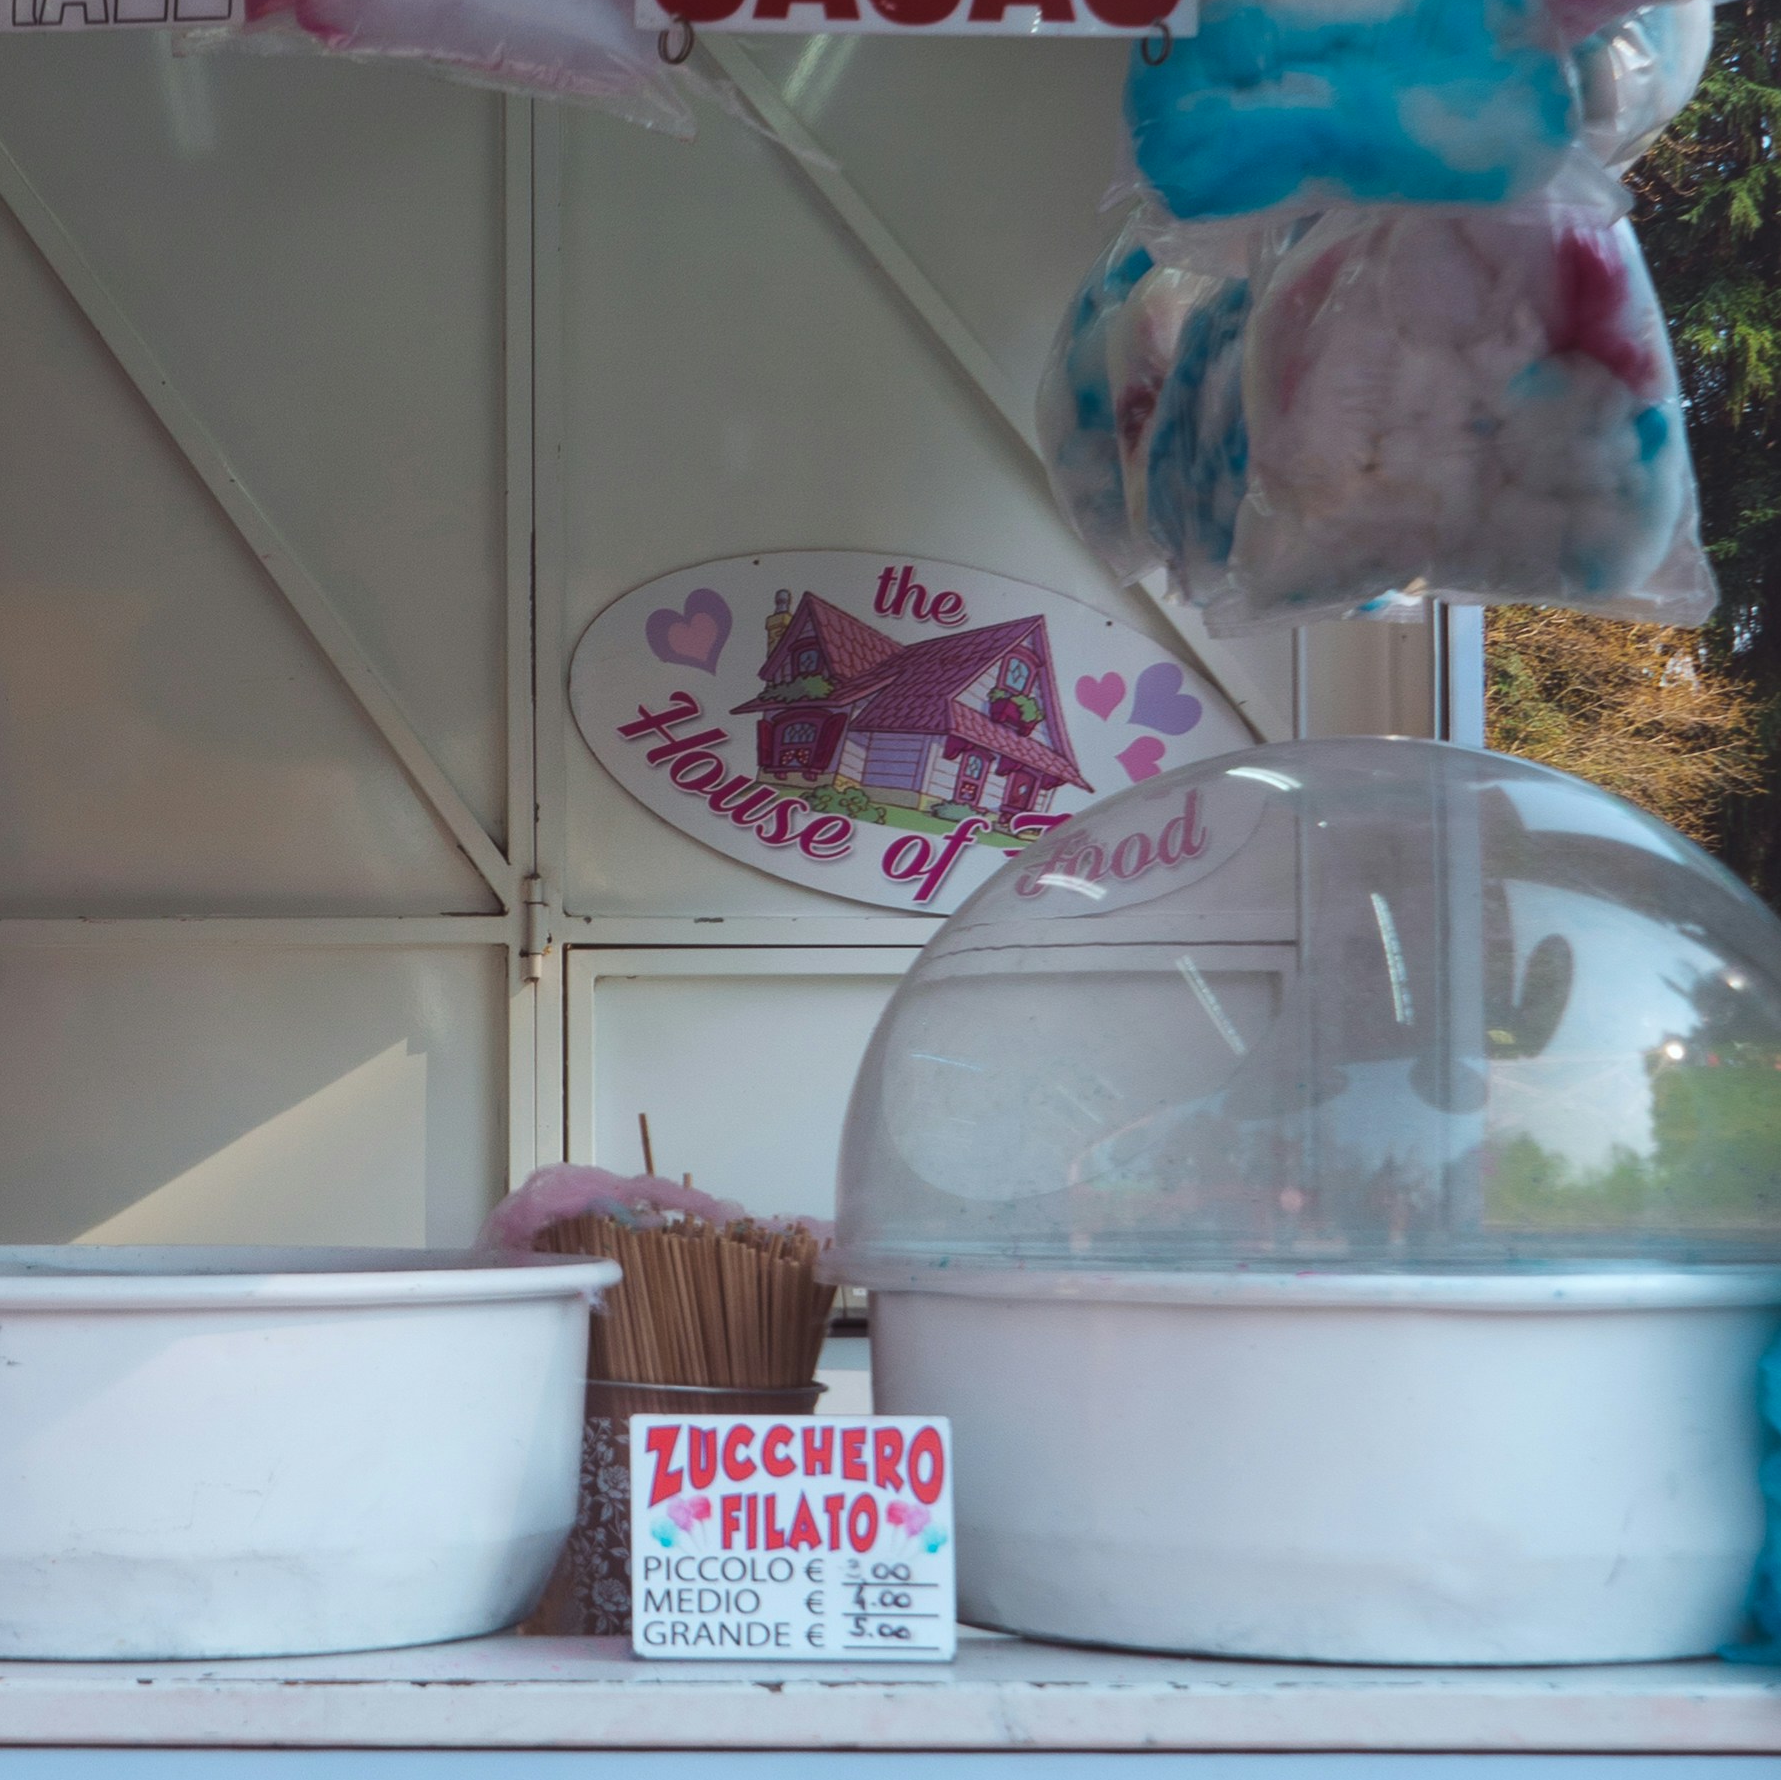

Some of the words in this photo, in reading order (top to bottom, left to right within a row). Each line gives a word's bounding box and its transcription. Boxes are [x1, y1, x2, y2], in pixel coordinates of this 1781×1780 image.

[872, 565, 968, 626] the
[616, 690, 854, 860] House
[882, 818, 990, 903] of
[1002, 787, 1209, 899] Food
[645, 1423, 945, 1508] ZUCCHERO
[720, 1489, 879, 1552] FILATO
[644, 1556, 795, 1582] PICCOLO
[804, 1559, 825, 1582] €
[643, 1589, 761, 1614] MEDIO
[804, 1590, 825, 1614] €
[643, 1621, 791, 1647] GRANDE
[804, 1623, 825, 1647] €
